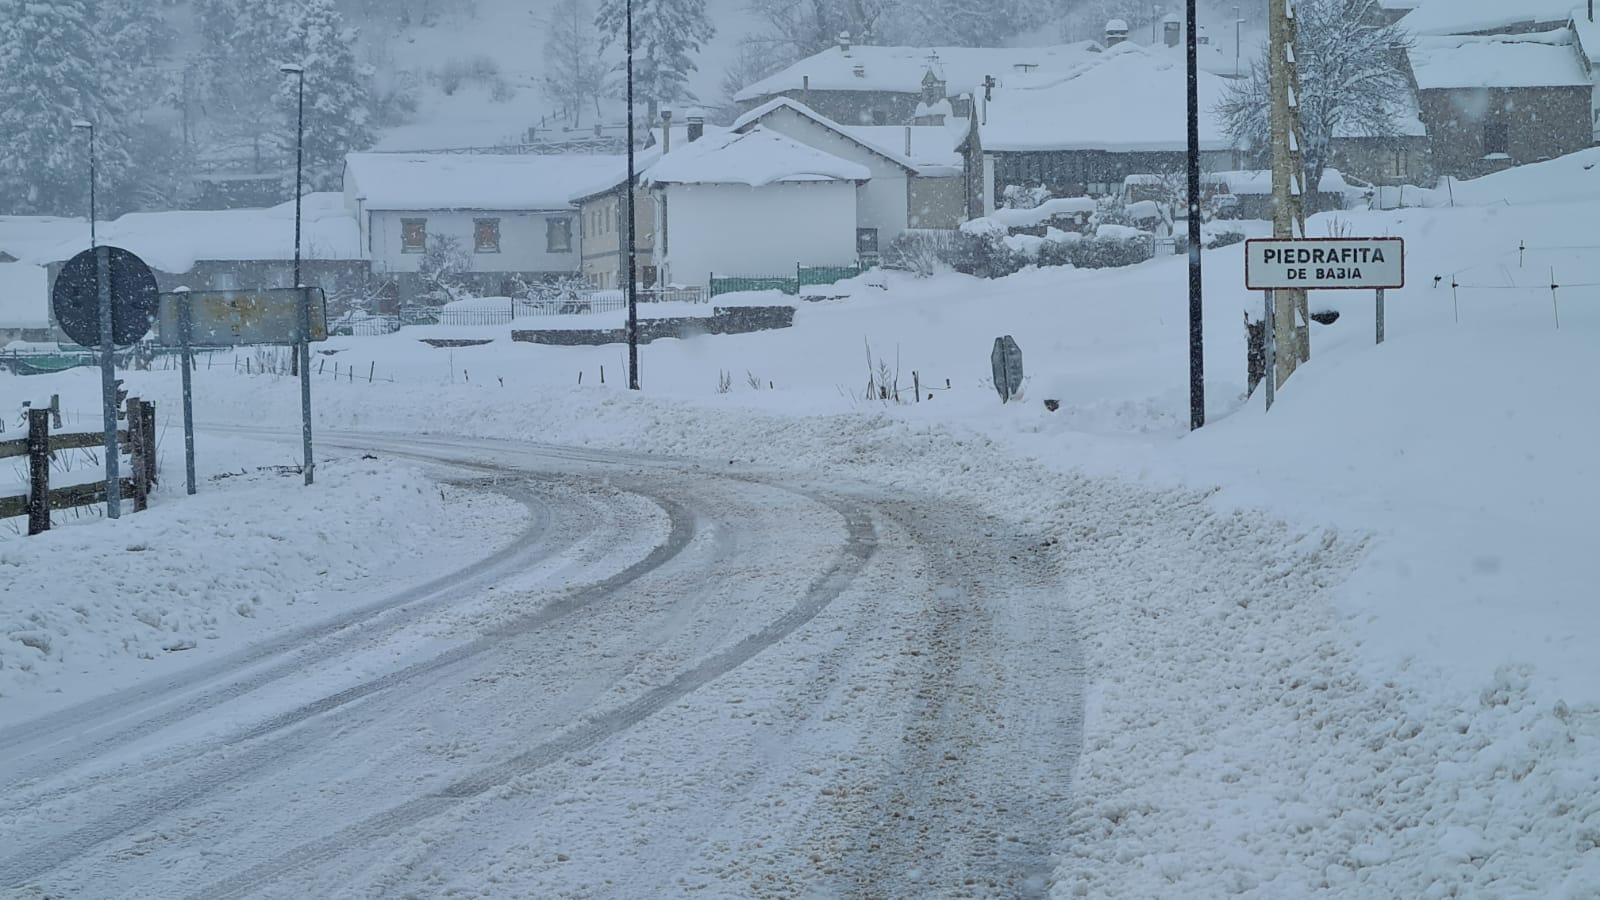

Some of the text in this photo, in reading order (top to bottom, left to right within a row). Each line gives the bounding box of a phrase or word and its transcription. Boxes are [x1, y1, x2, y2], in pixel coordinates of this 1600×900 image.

[1263, 247, 1385, 264] PIEDRAFITA
[1287, 267, 1362, 280] DE BABIA
